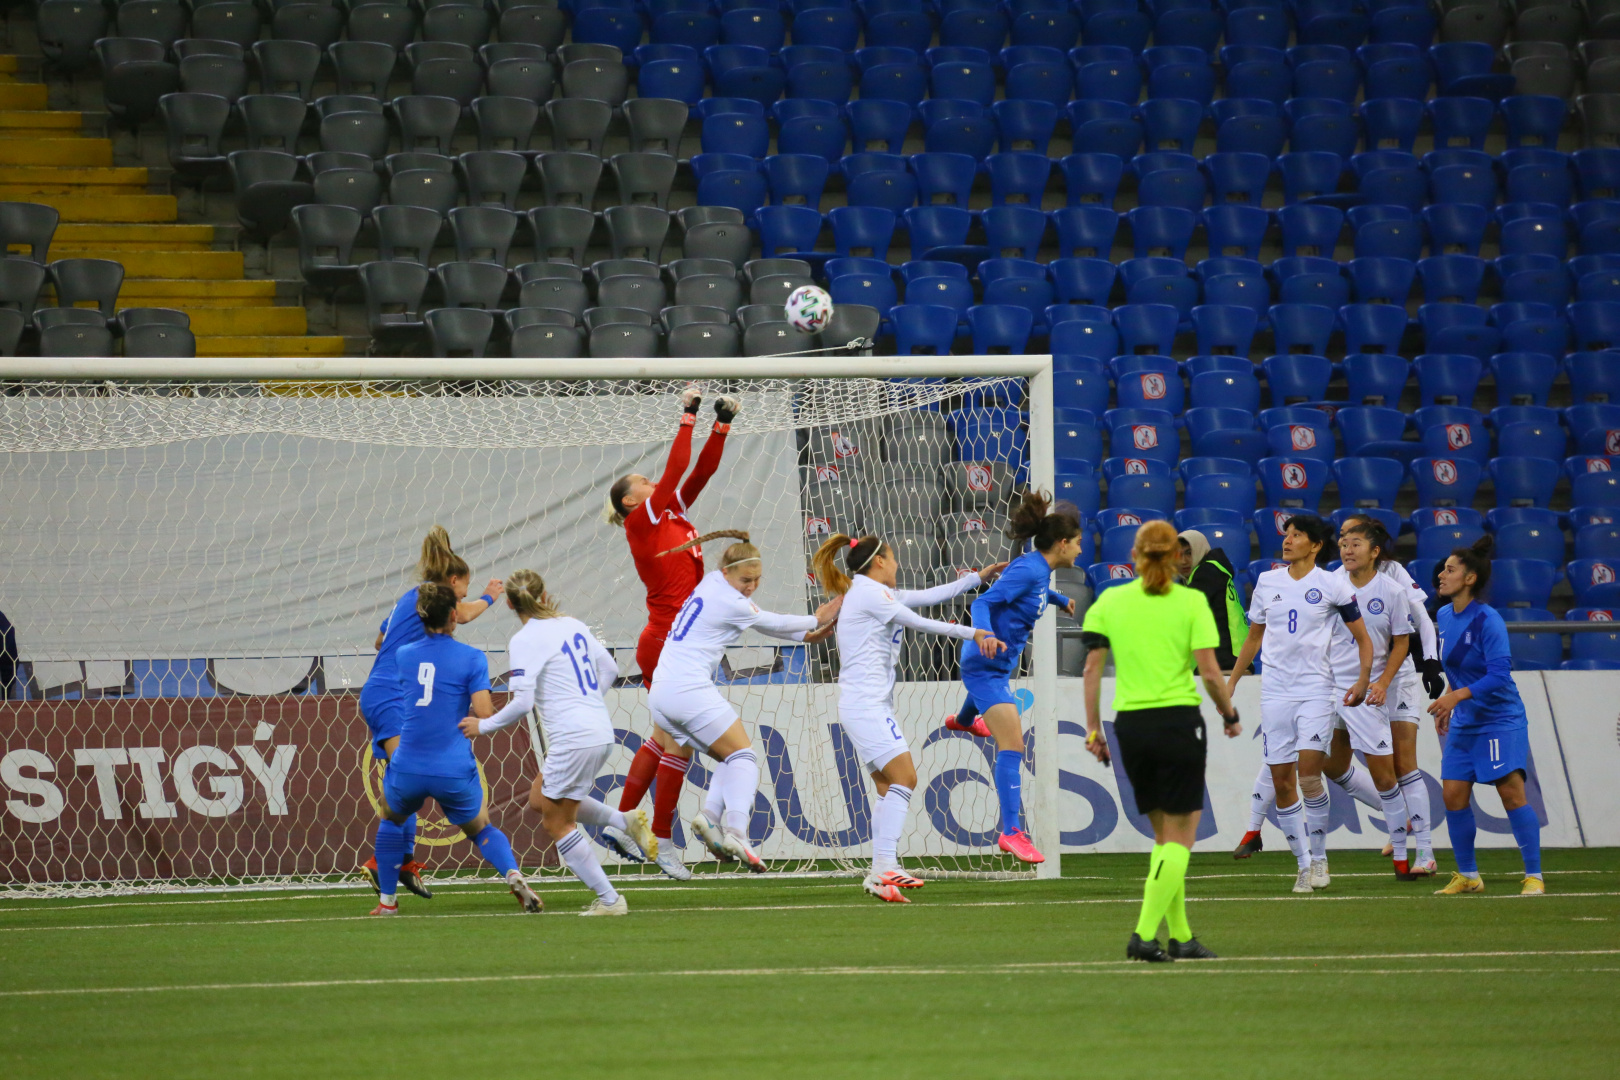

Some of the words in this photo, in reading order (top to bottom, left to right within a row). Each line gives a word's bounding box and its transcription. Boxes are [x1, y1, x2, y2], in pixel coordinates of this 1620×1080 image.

[1288, 608, 1298, 634] 8
[561, 633, 598, 696] 13
[415, 662, 436, 707] 9
[886, 717, 903, 740] 2
[1488, 738, 1500, 762] 11
